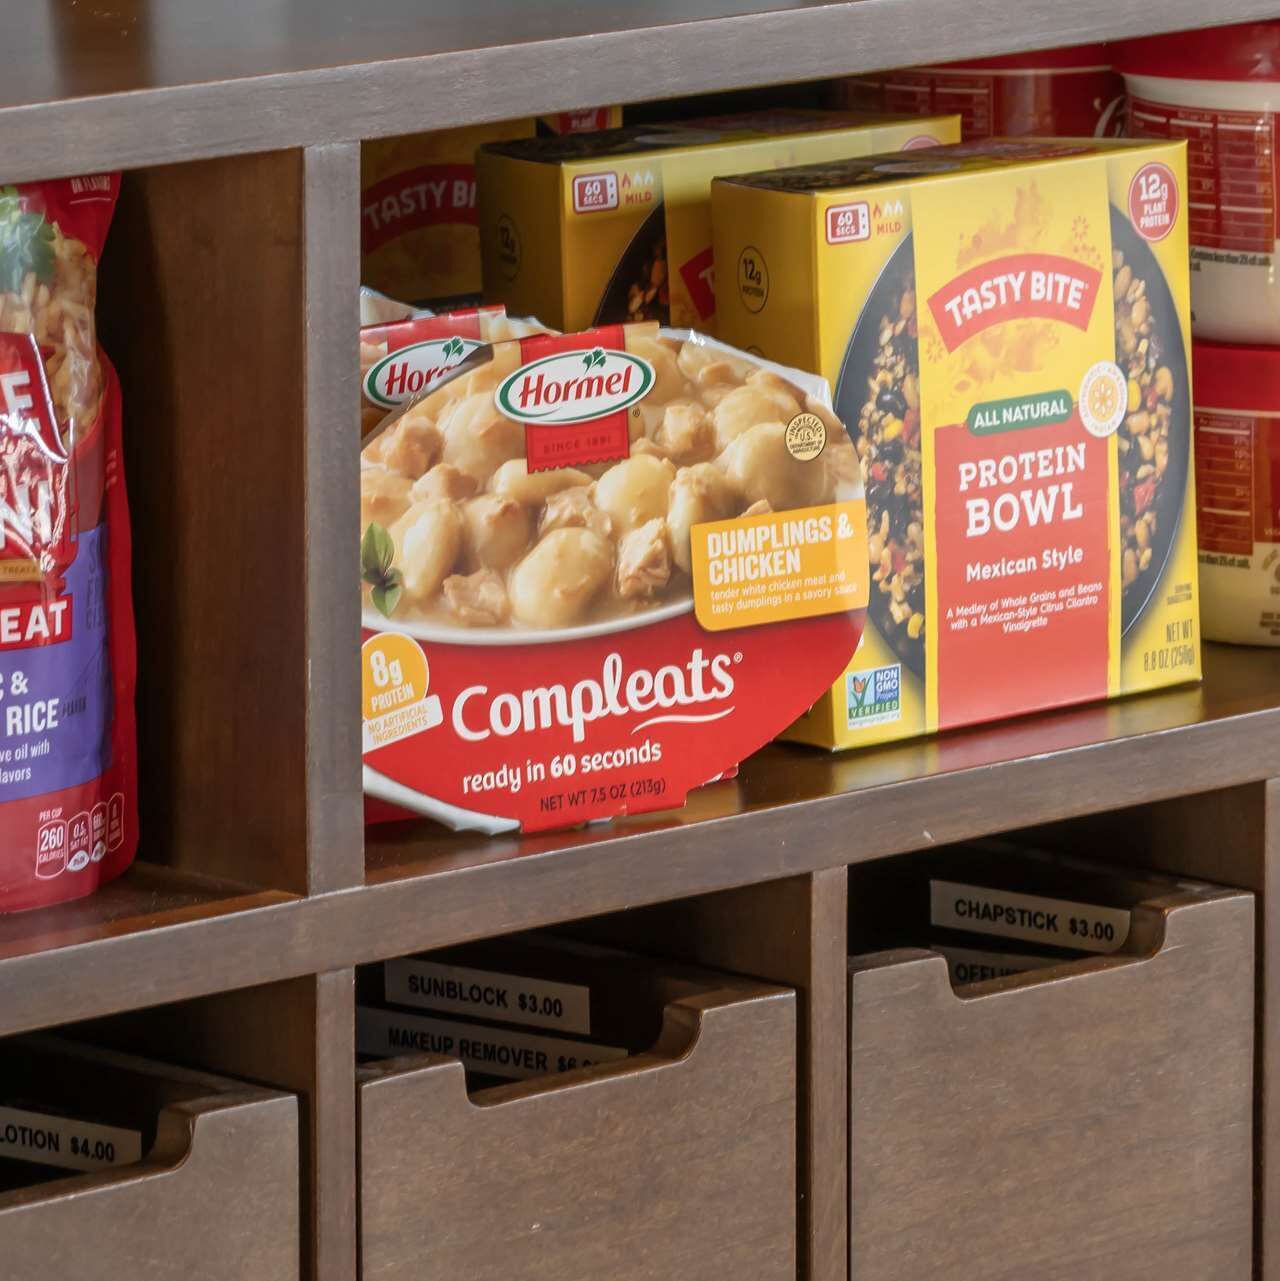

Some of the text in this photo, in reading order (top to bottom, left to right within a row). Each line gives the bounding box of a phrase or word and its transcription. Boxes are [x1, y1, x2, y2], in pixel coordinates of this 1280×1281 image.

[585, 181, 600, 196] 60
[626, 190, 652, 205] MILD
[1138, 173, 1169, 202] 12g
[838, 211, 853, 226] 60
[1139, 211, 1170, 229] PROTEIN
[1143, 201, 1167, 216] PLANT
[876, 221, 903, 235] MILD
[944, 270, 1086, 327] TASTY BITE
[518, 364, 632, 410] Hormel
[974, 398, 1069, 430] ALL NATURAL
[958, 442, 1087, 492] PROTEIN
[966, 482, 1083, 538] BOWL
[707, 513, 854, 559] DUMPLINGS &
[710, 548, 801, 586] CHICKEN
[966, 545, 1084, 583] Mexican Style
[711, 570, 846, 601] tender white chicken meat and
[712, 600, 733, 615] tasty
[736, 592, 782, 610] dumplings
[803, 587, 832, 602] savory
[0, 600, 67, 645] EAT
[11, 670, 29, 695] &
[370, 649, 403, 688] 8g
[876, 669, 898, 683] NON
[370, 682, 414, 712] PROTEIN
[451, 647, 736, 745] Compleats
[876, 679, 898, 694] GMO
[6, 698, 58, 738] RICE
[849, 700, 899, 717] VERIFIED
[372, 715, 429, 744] INGREDIENTS
[14, 744, 28, 761] oil
[30, 740, 51, 758] with
[462, 739, 662, 798] ready in 60 seconds
[540, 777, 667, 813] NET WT 7.5 OZ (213g)
[40, 824, 64, 852] 260
[955, 899, 1114, 943] CHAPSTICK $3.00
[408, 974, 563, 1018] SUNBLOCK $3.00
[388, 1027, 548, 1071] MAKEUP REMOVER
[70, 1136, 115, 1163] $4.00
